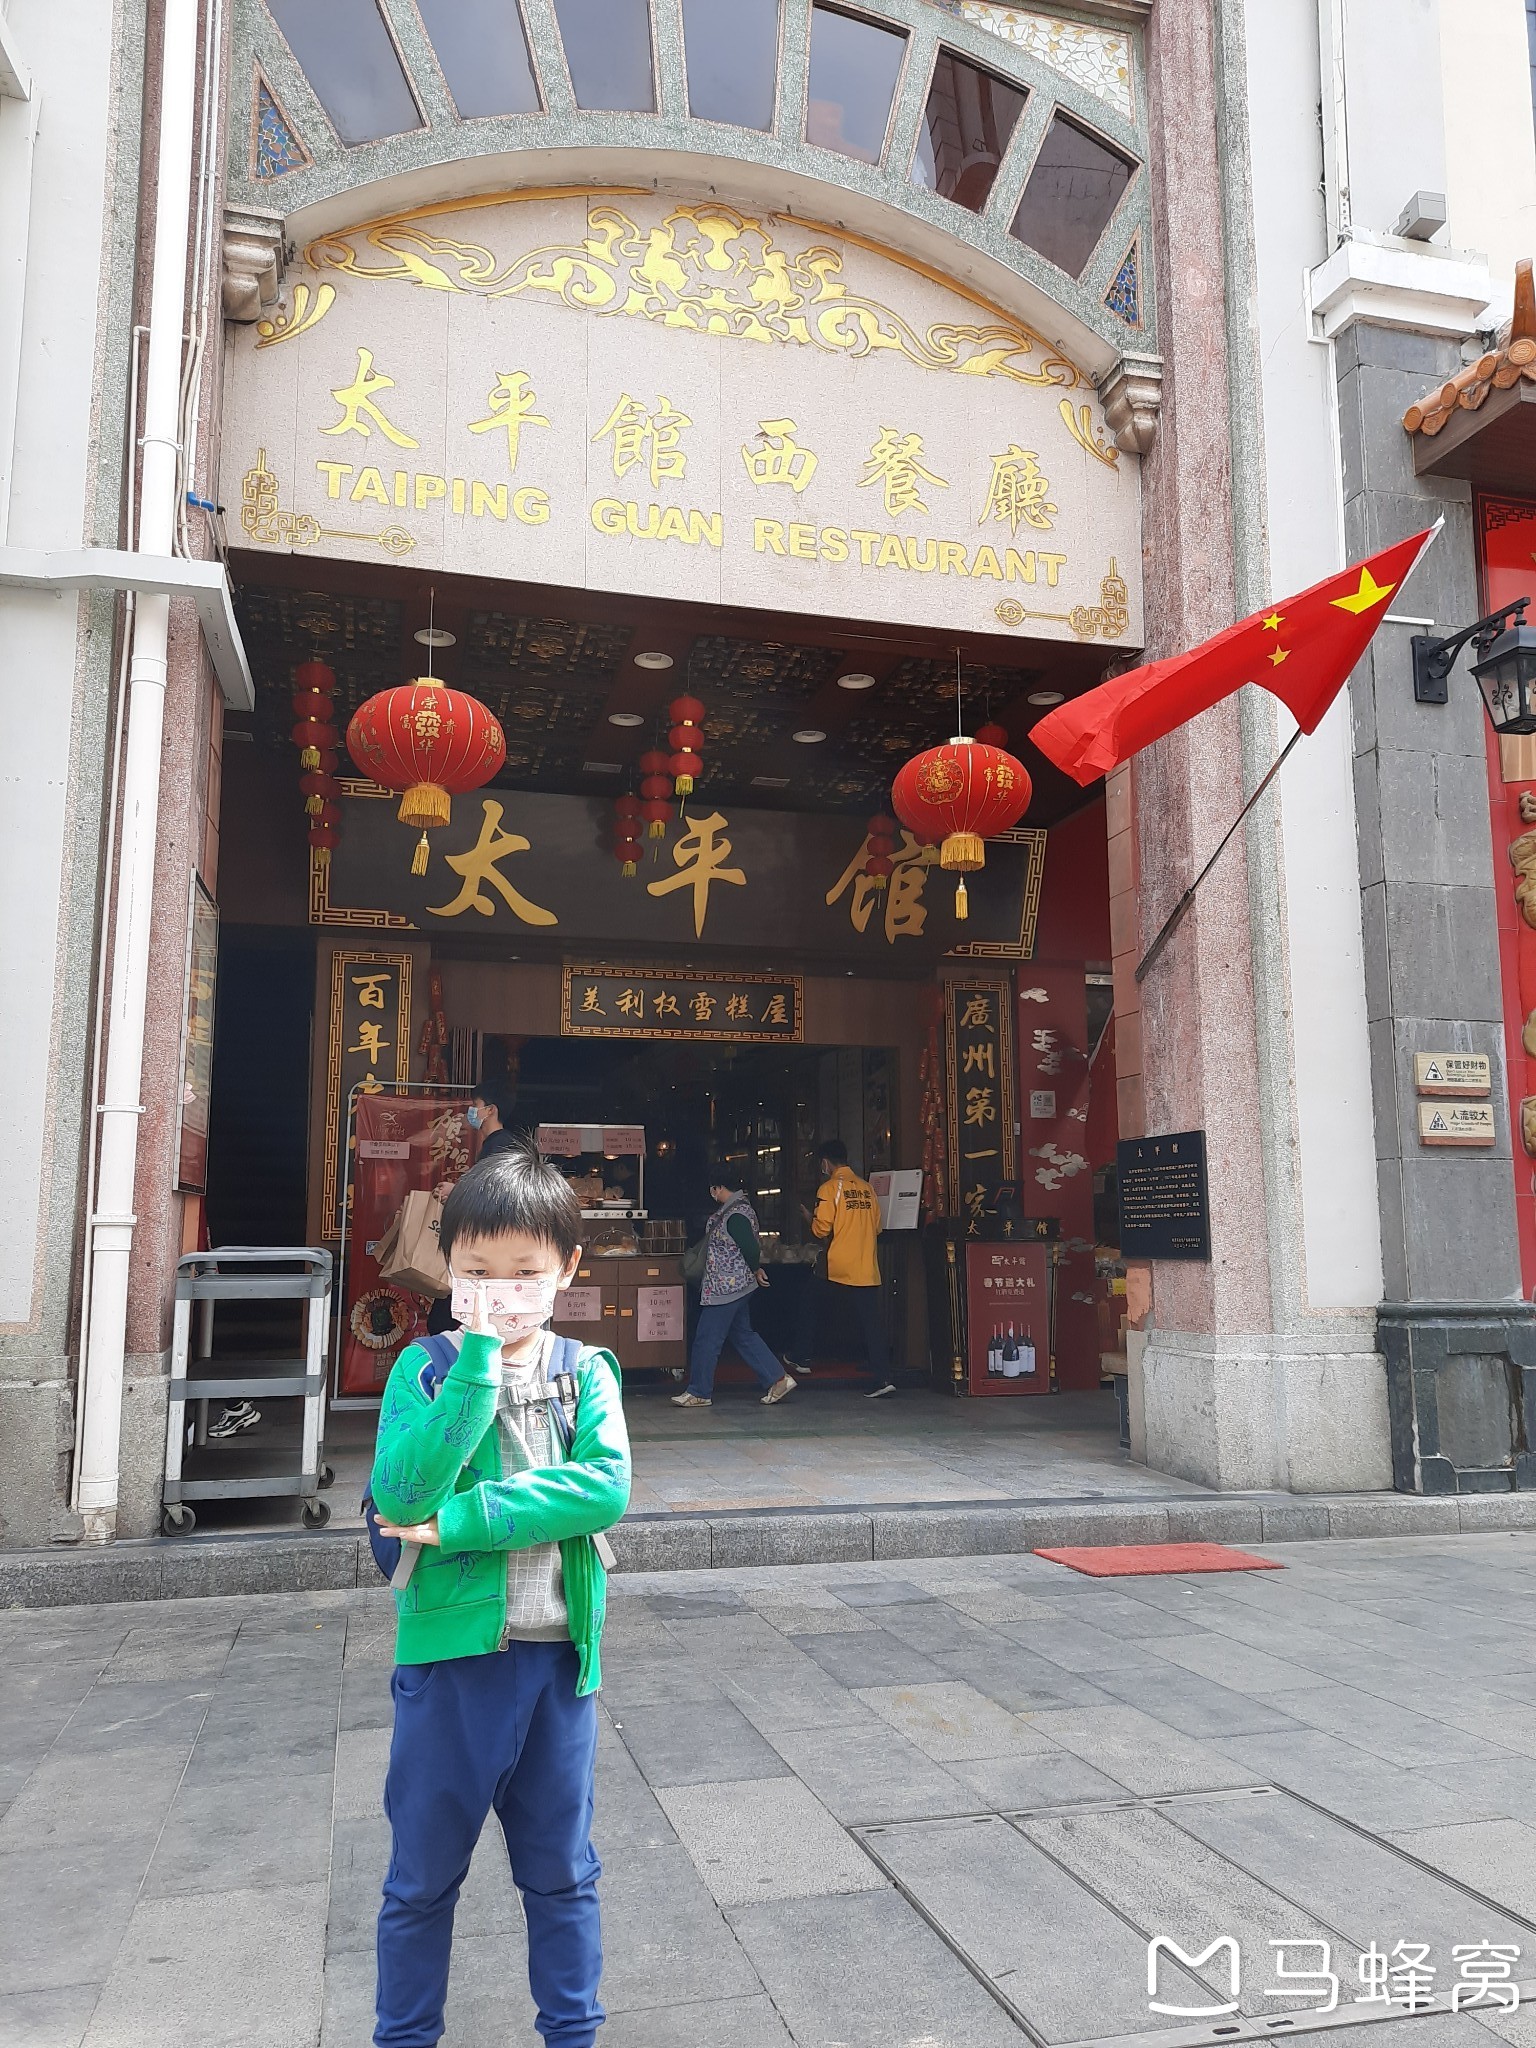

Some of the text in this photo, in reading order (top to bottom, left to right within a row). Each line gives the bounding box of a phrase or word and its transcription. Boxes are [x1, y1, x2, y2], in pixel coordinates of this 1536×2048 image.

[318, 346, 1059, 539] 太平館西餐廳
[316, 460, 1068, 587] TAIPING GUAN RESTAURANT
[579, 985, 789, 1024] 美利权雪糕屋
[1446, 1060, 1487, 1070] 保管好财物
[959, 994, 999, 1217] 廣州第一家
[1450, 1110, 1488, 1120] 人流较大
[983, 1277, 1035, 1288] 春节送大礼
